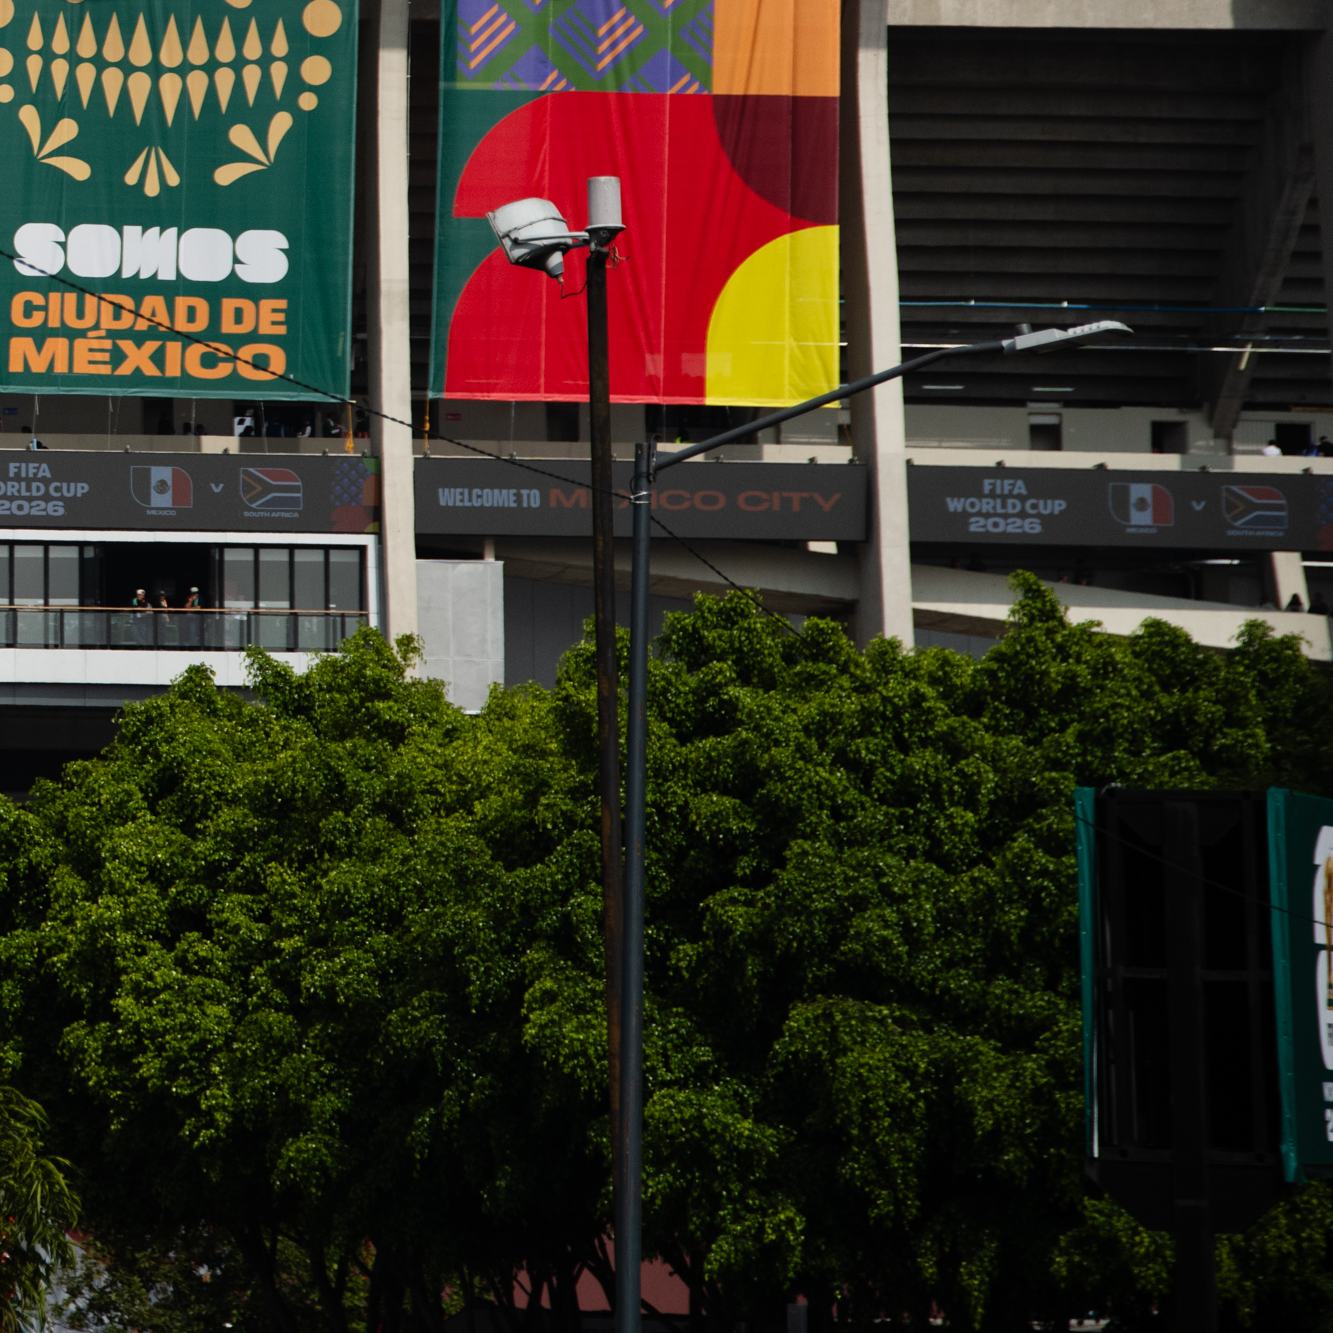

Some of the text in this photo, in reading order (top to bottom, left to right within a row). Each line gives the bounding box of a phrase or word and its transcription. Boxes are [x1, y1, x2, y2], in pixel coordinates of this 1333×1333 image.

[13, 222, 290, 284] SOMOS
[10, 291, 288, 335] CIUDAD DE
[8, 329, 287, 381] MÉXICO
[8, 462, 52, 479] FIFA
[50, 481, 90, 498] CUP
[983, 479, 1027, 495] FIFA
[438, 488, 841, 512] WELCOME TO MICO CITY
[946, 497, 1067, 515] WORLD CUP
[968, 517, 1043, 533] 2026
